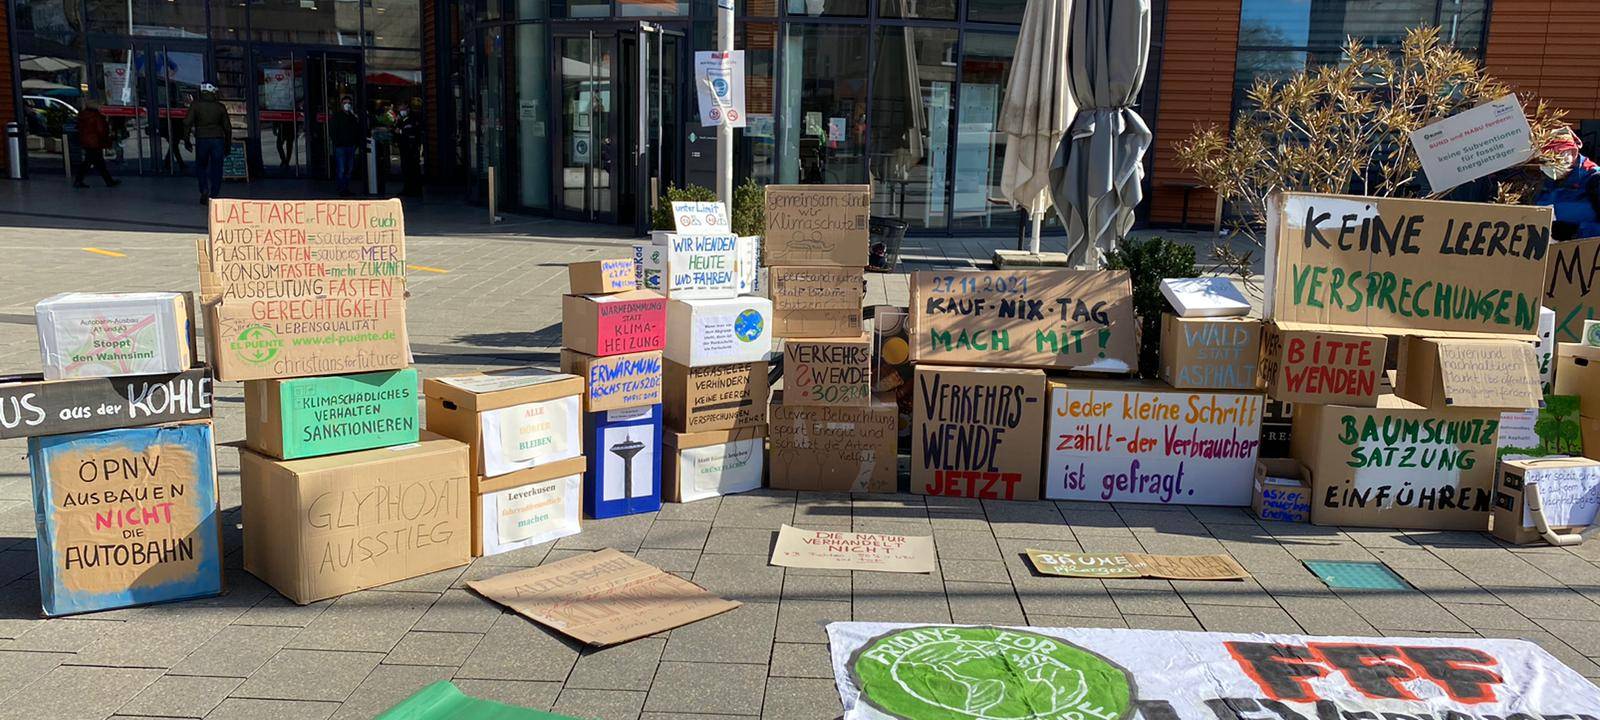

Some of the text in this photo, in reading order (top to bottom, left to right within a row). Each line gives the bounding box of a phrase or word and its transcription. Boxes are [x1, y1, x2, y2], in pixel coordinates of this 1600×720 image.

[1438, 128, 1522, 162] keine Subventionen
[1461, 143, 1504, 162] für fossile
[1457, 148, 1515, 173] Energieträger
[768, 192, 868, 210] gemeinsam sind
[214, 202, 397, 228] LAETARE FREUT euch
[769, 212, 856, 231] Klimaschutz
[799, 208, 821, 216] wir
[214, 228, 252, 245] AUTO
[365, 230, 398, 244] LUFT
[673, 236, 737, 253] WIR WENDEN
[1439, 217, 1550, 262] LEEREN
[215, 246, 268, 262] PLASTIK
[361, 245, 398, 261] MEER
[688, 255, 725, 270] HEUTE
[675, 271, 733, 286] UND FAHREN
[932, 276, 1028, 294] 27.11.2021
[224, 279, 393, 299] AUSBEUTUNG FASTEN
[1292, 263, 1539, 332] VERSPRECHUNGEN
[251, 298, 392, 321] GERECHTIGKEIT
[276, 319, 378, 335] LEBENSQUALITÄT
[615, 324, 656, 336] KLIMA-
[1184, 323, 1249, 348] WALD
[93, 338, 131, 349] Stoppt
[292, 331, 395, 346] www.el-puente.de
[605, 336, 659, 352] HEIZUNG
[931, 327, 1009, 352] MACH
[72, 350, 154, 362] den Wahnsinn!
[356, 349, 399, 370] future
[590, 357, 661, 386] ERWÄRMUNG
[812, 367, 869, 385] WENDE
[1179, 364, 1256, 388] ASPHALT
[1284, 365, 1376, 396] WENDEN
[695, 375, 750, 390] VERHINDERN
[59, 405, 92, 420] aus
[97, 403, 122, 416] der
[127, 377, 212, 419] KOHLE
[694, 390, 750, 406] KEINE LEEREN
[920, 373, 1038, 429] VERKEHRS-
[314, 404, 381, 422] VERHALTEN
[524, 406, 545, 418] ALLE
[688, 410, 750, 426] VERSPRECHUNGEN
[774, 408, 895, 430] Clevere Beleuchtung
[1057, 391, 1113, 417] Jeder
[1122, 393, 1181, 421] kleine
[1185, 394, 1258, 428] Schritt
[303, 416, 413, 442] SANKTIONIEREN
[774, 423, 884, 441] spart Energie und
[1338, 414, 1501, 446] BAUMSCHUTZ
[519, 436, 552, 451] BLEIBEN
[923, 422, 1005, 472] WENDE
[1164, 424, 1259, 459] Verbraucher
[79, 455, 160, 483] ÖPNV
[1346, 446, 1477, 472] SATZUNG
[926, 470, 1022, 501] JETZT
[1064, 462, 1087, 491] ist
[63, 484, 184, 507] AUSBAUEN
[508, 484, 556, 501] Leverkusen
[1324, 479, 1492, 513] EINFÜHREN
[307, 476, 468, 530] GLYPHOSAT
[95, 502, 175, 531] NICHT
[517, 513, 549, 528] machen
[122, 528, 145, 539] DIE
[802, 537, 902, 548] VERHANDELT
[816, 532, 906, 544] DIE NATUR
[65, 537, 194, 570] AUTOBAHN
[319, 521, 454, 575] AUSSTIEG
[828, 545, 895, 554] NICHT
[1037, 553, 1127, 567] BÄUME
[864, 628, 1058, 666] FRIDAYS FOR
[1223, 641, 1504, 703] FFF
